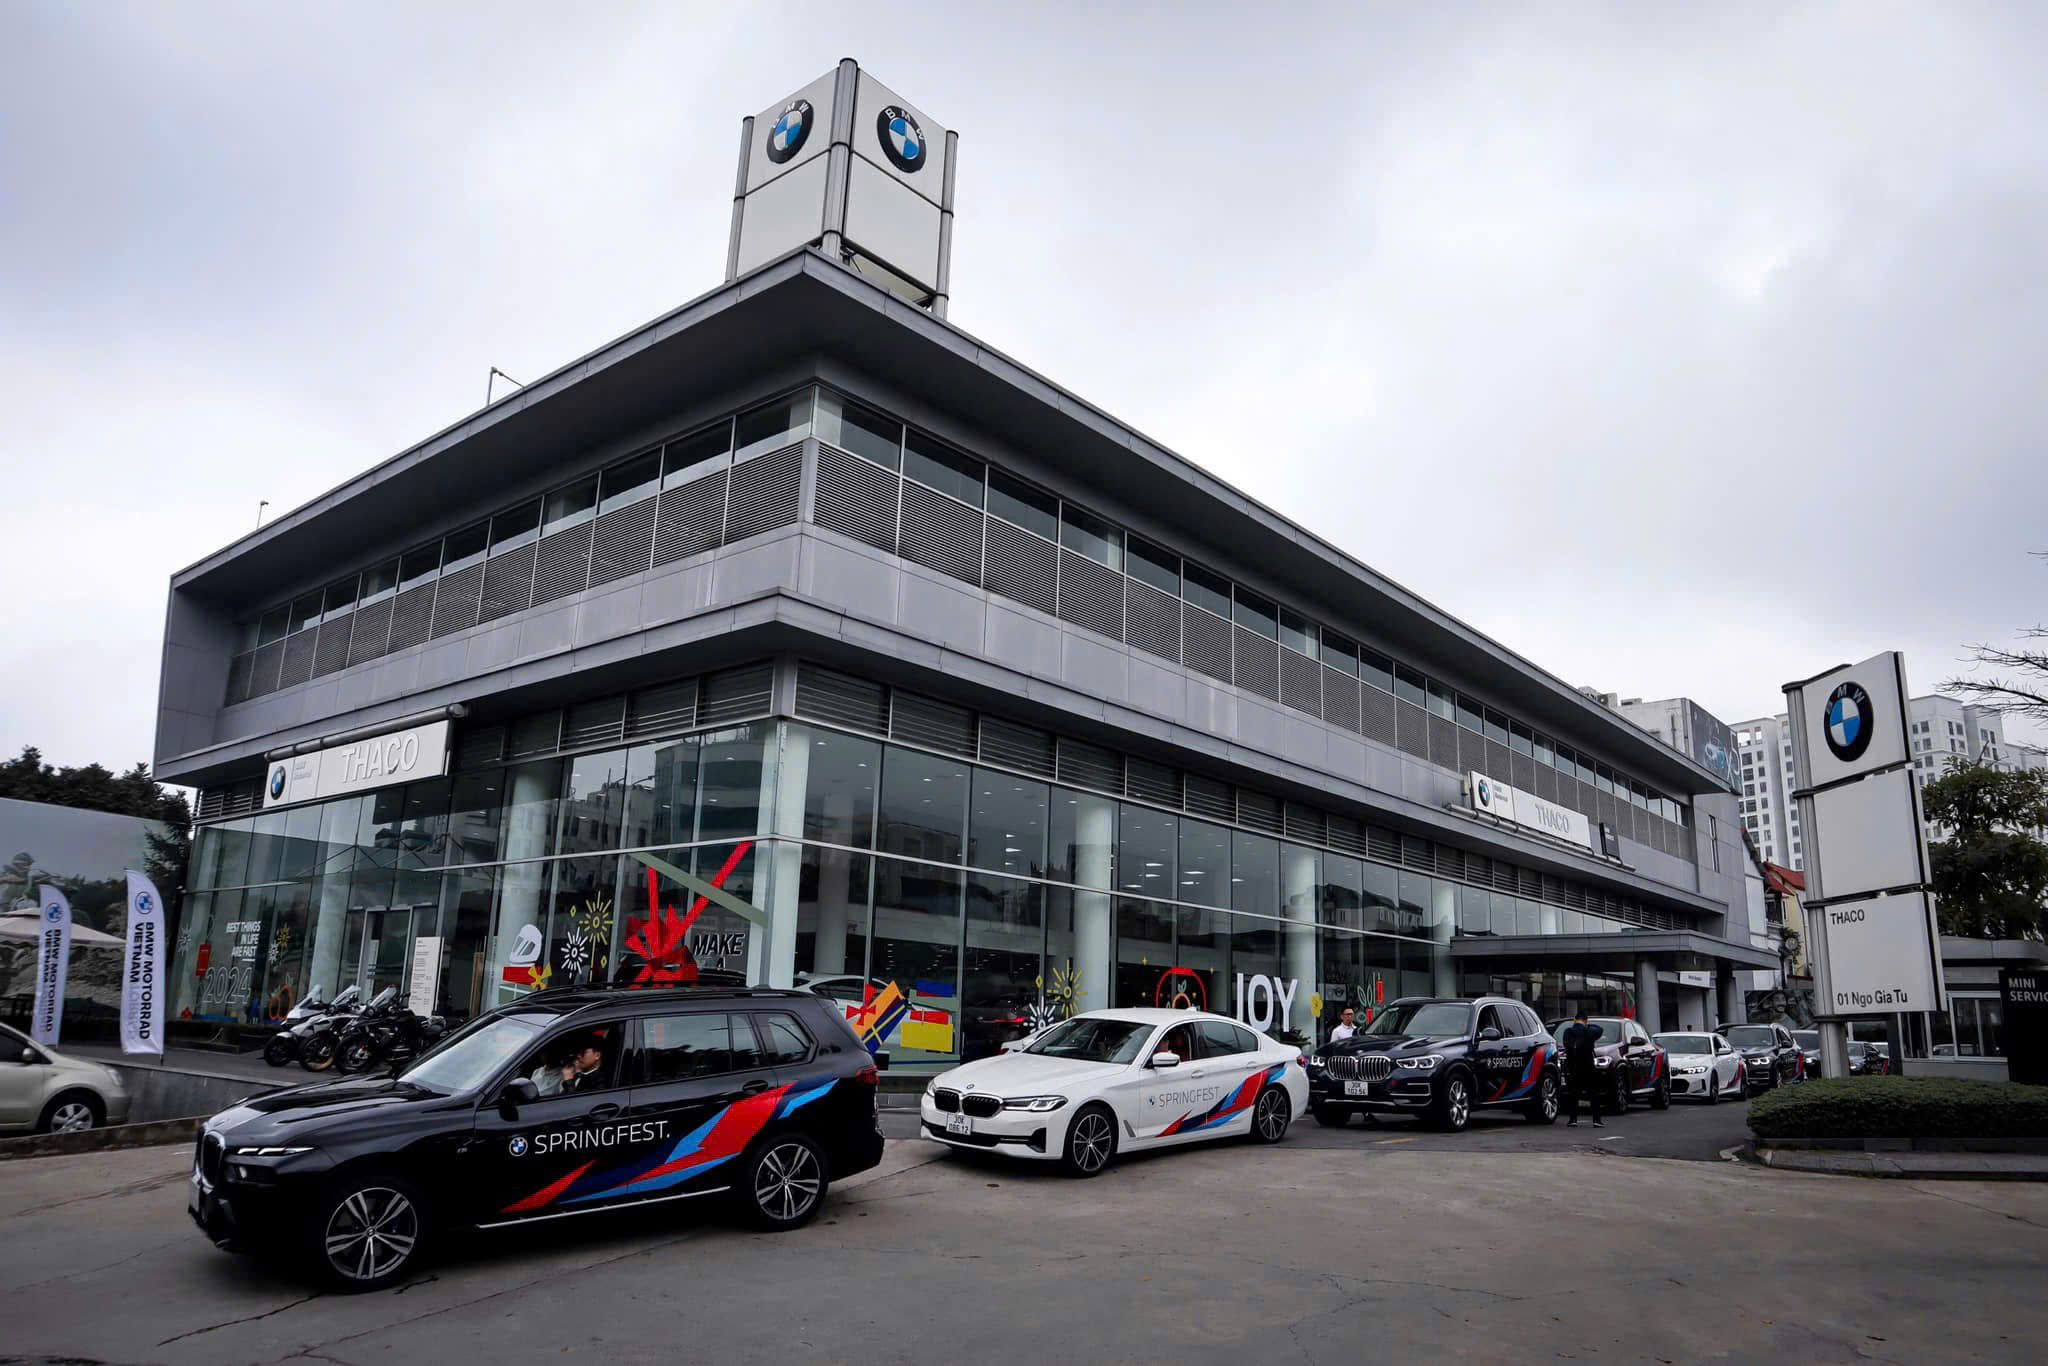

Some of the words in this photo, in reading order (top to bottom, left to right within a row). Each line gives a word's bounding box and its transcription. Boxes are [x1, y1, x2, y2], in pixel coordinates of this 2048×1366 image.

[885, 108, 925, 140] BMW
[342, 732, 420, 784] THACO
[1534, 803, 1569, 834] THACO
[241, 920, 262, 932] THINGS
[1830, 908, 1865, 926] THACO
[52, 929, 62, 959] BMW
[129, 922, 145, 983] VIETNAM
[145, 921, 154, 957] BMW
[231, 945, 242, 957] ARE
[243, 945, 258, 957] FAST
[248, 933, 260, 945] LIFE
[693, 932, 746, 957] MAKE
[42, 929, 53, 983] VIETNAM
[46, 962, 58, 1032] MOTORRAD
[201, 967, 252, 1005] 2024
[1837, 992, 1849, 1006] 01
[1851, 992, 1873, 1008] Ngo
[1874, 990, 1893, 1004] Gia
[1893, 989, 1908, 1004] Tu
[2008, 977, 2036, 989] MINI
[139, 960, 153, 1040] MOTORRAD
[1236, 972, 1298, 1033] JOY
[534, 1120, 671, 1154] SPRINGFEST.
